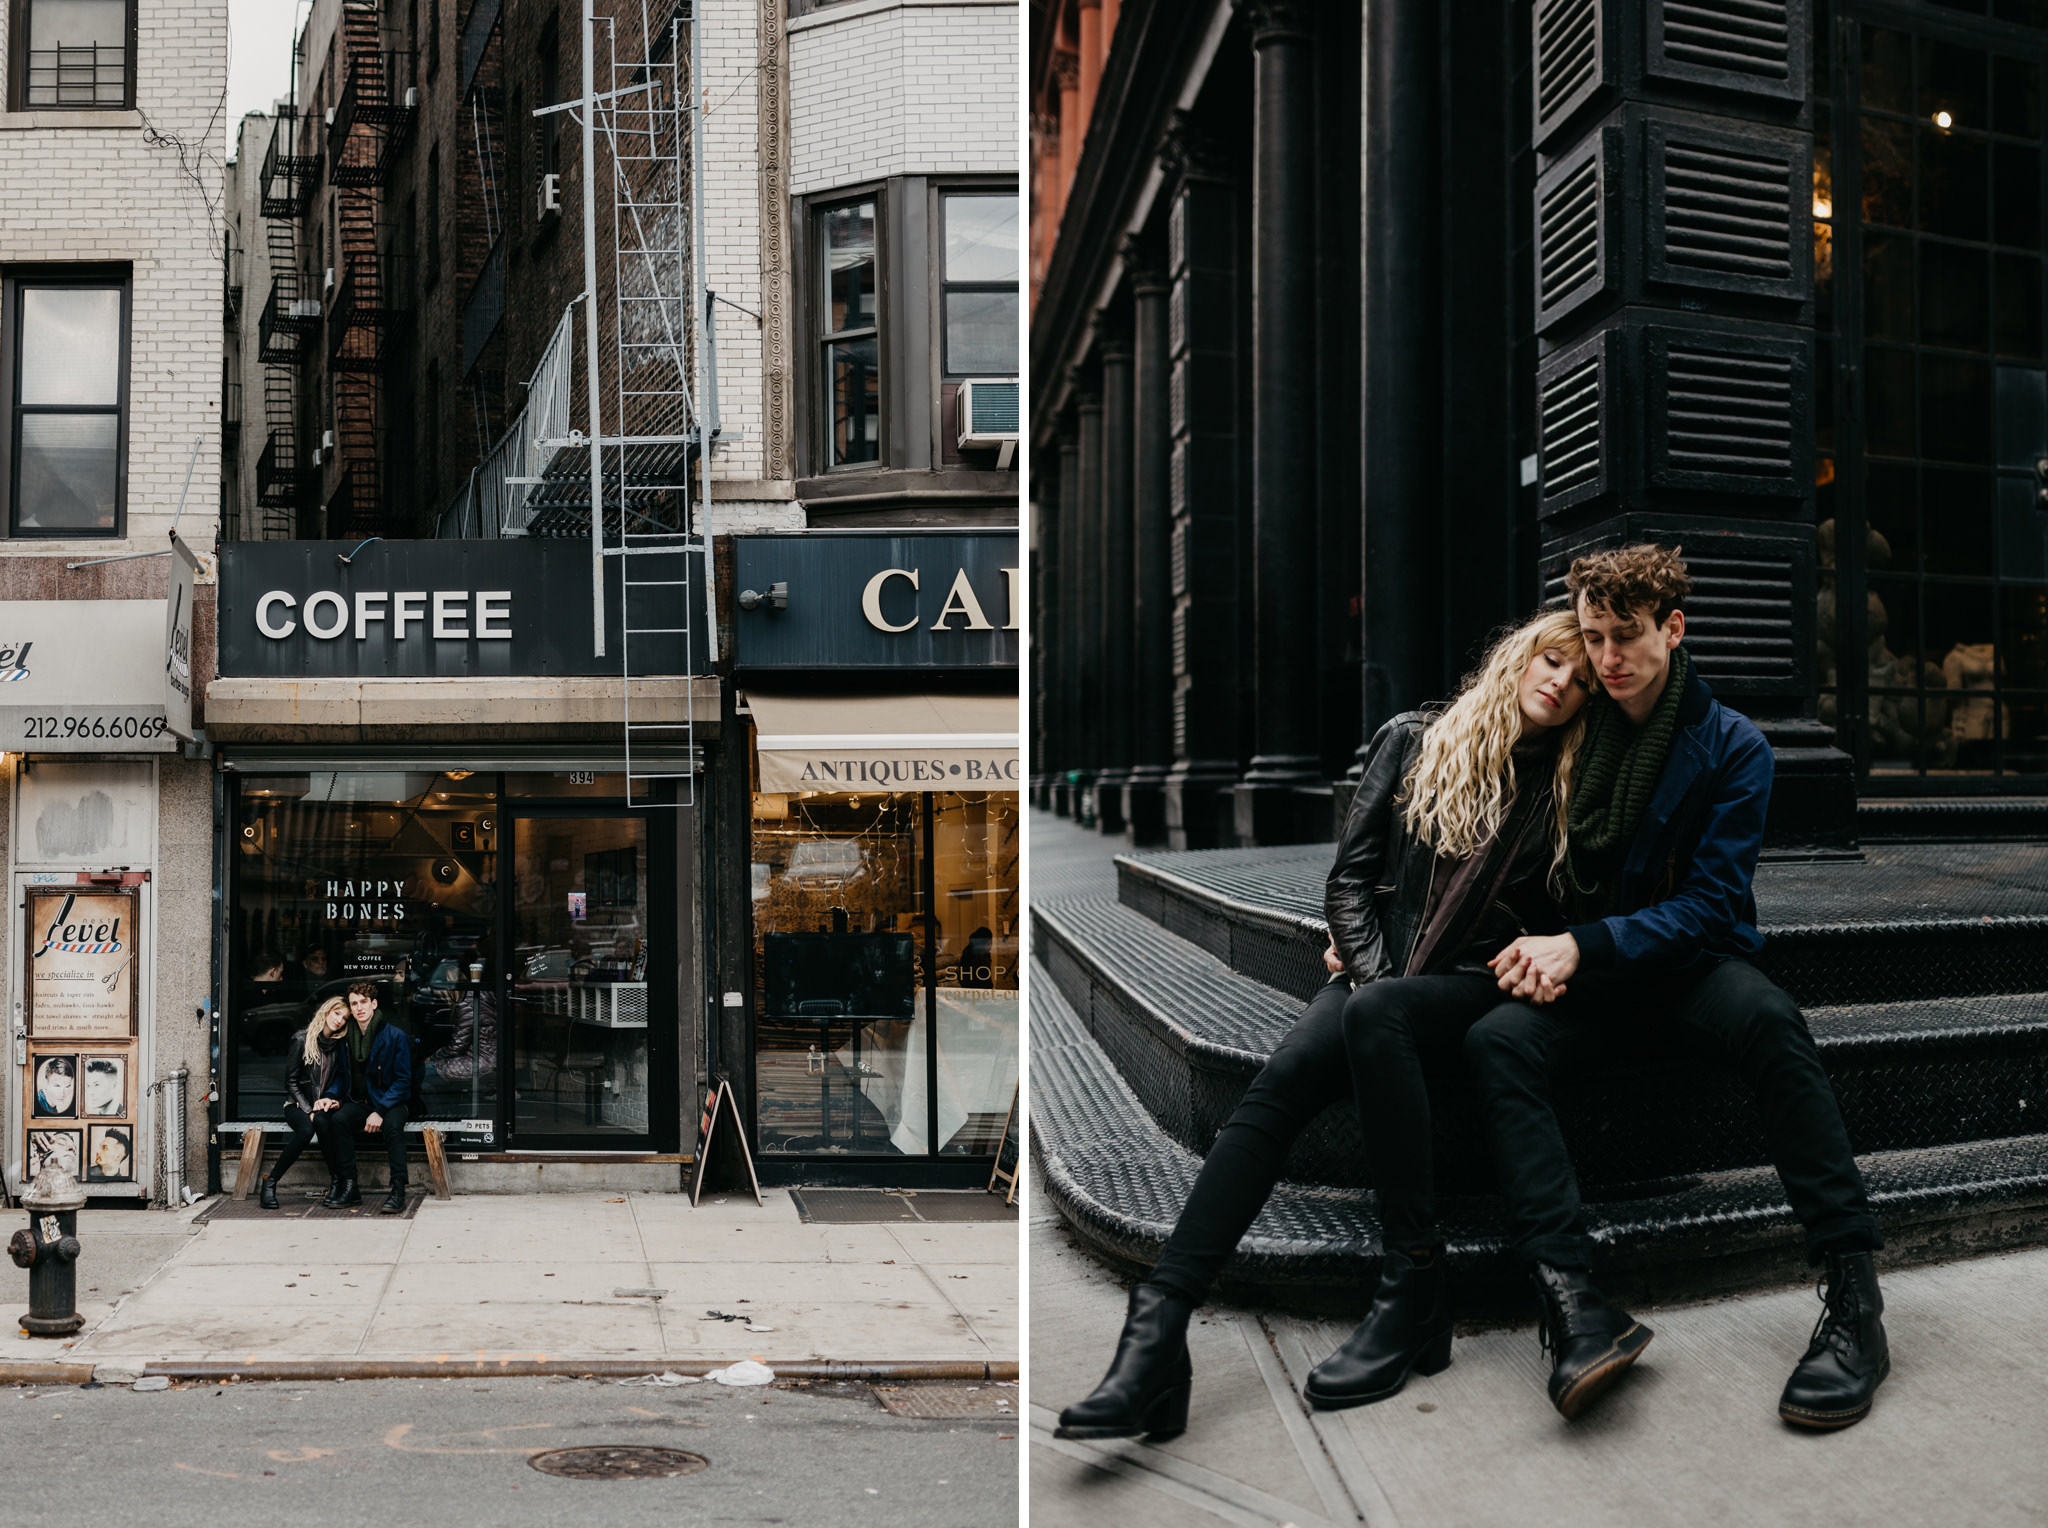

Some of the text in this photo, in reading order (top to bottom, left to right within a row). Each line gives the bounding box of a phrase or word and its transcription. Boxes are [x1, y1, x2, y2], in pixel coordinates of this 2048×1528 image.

[255, 590, 512, 639] COFFEE
[24, 717, 163, 738] 212.966.6069
[571, 771, 593, 783] 394
[800, 759, 946, 786] ANTIQUES
[327, 881, 404, 897] HAPPY
[327, 903, 404, 919] BONES
[48, 970, 84, 980] specialize
[87, 970, 94, 978] in
[945, 966, 1006, 980] SHOP
